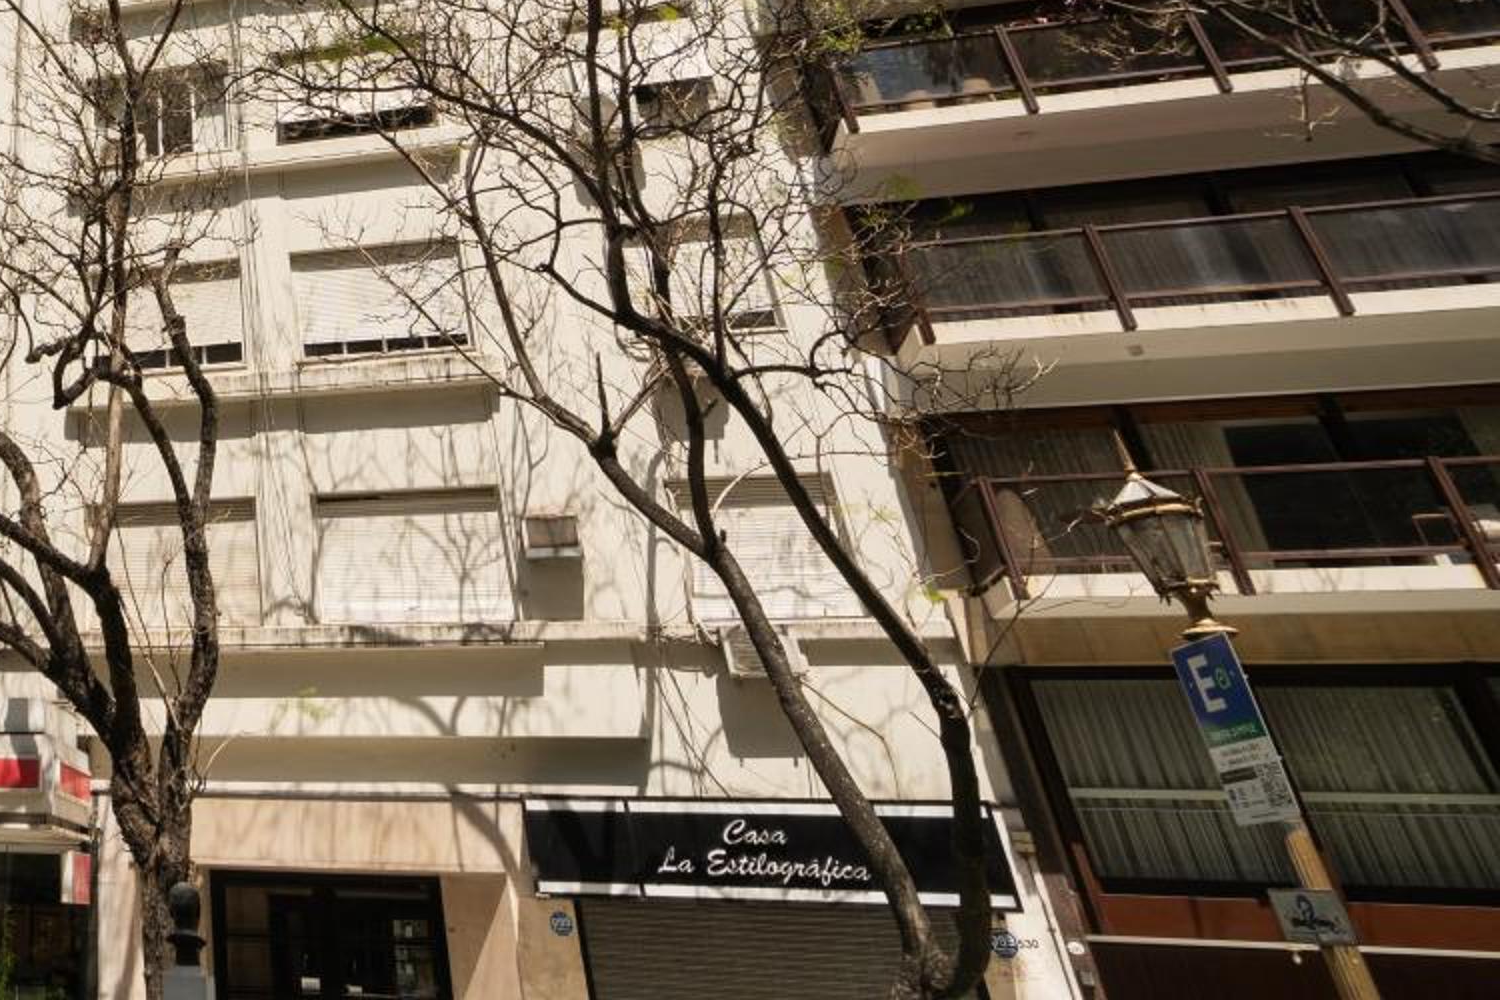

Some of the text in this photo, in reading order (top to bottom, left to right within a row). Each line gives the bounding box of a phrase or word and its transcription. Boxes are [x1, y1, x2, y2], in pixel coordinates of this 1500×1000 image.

[1187, 653, 1227, 713] E
[722, 819, 788, 845] Casa
[657, 846, 872, 887] La Estilográfica
